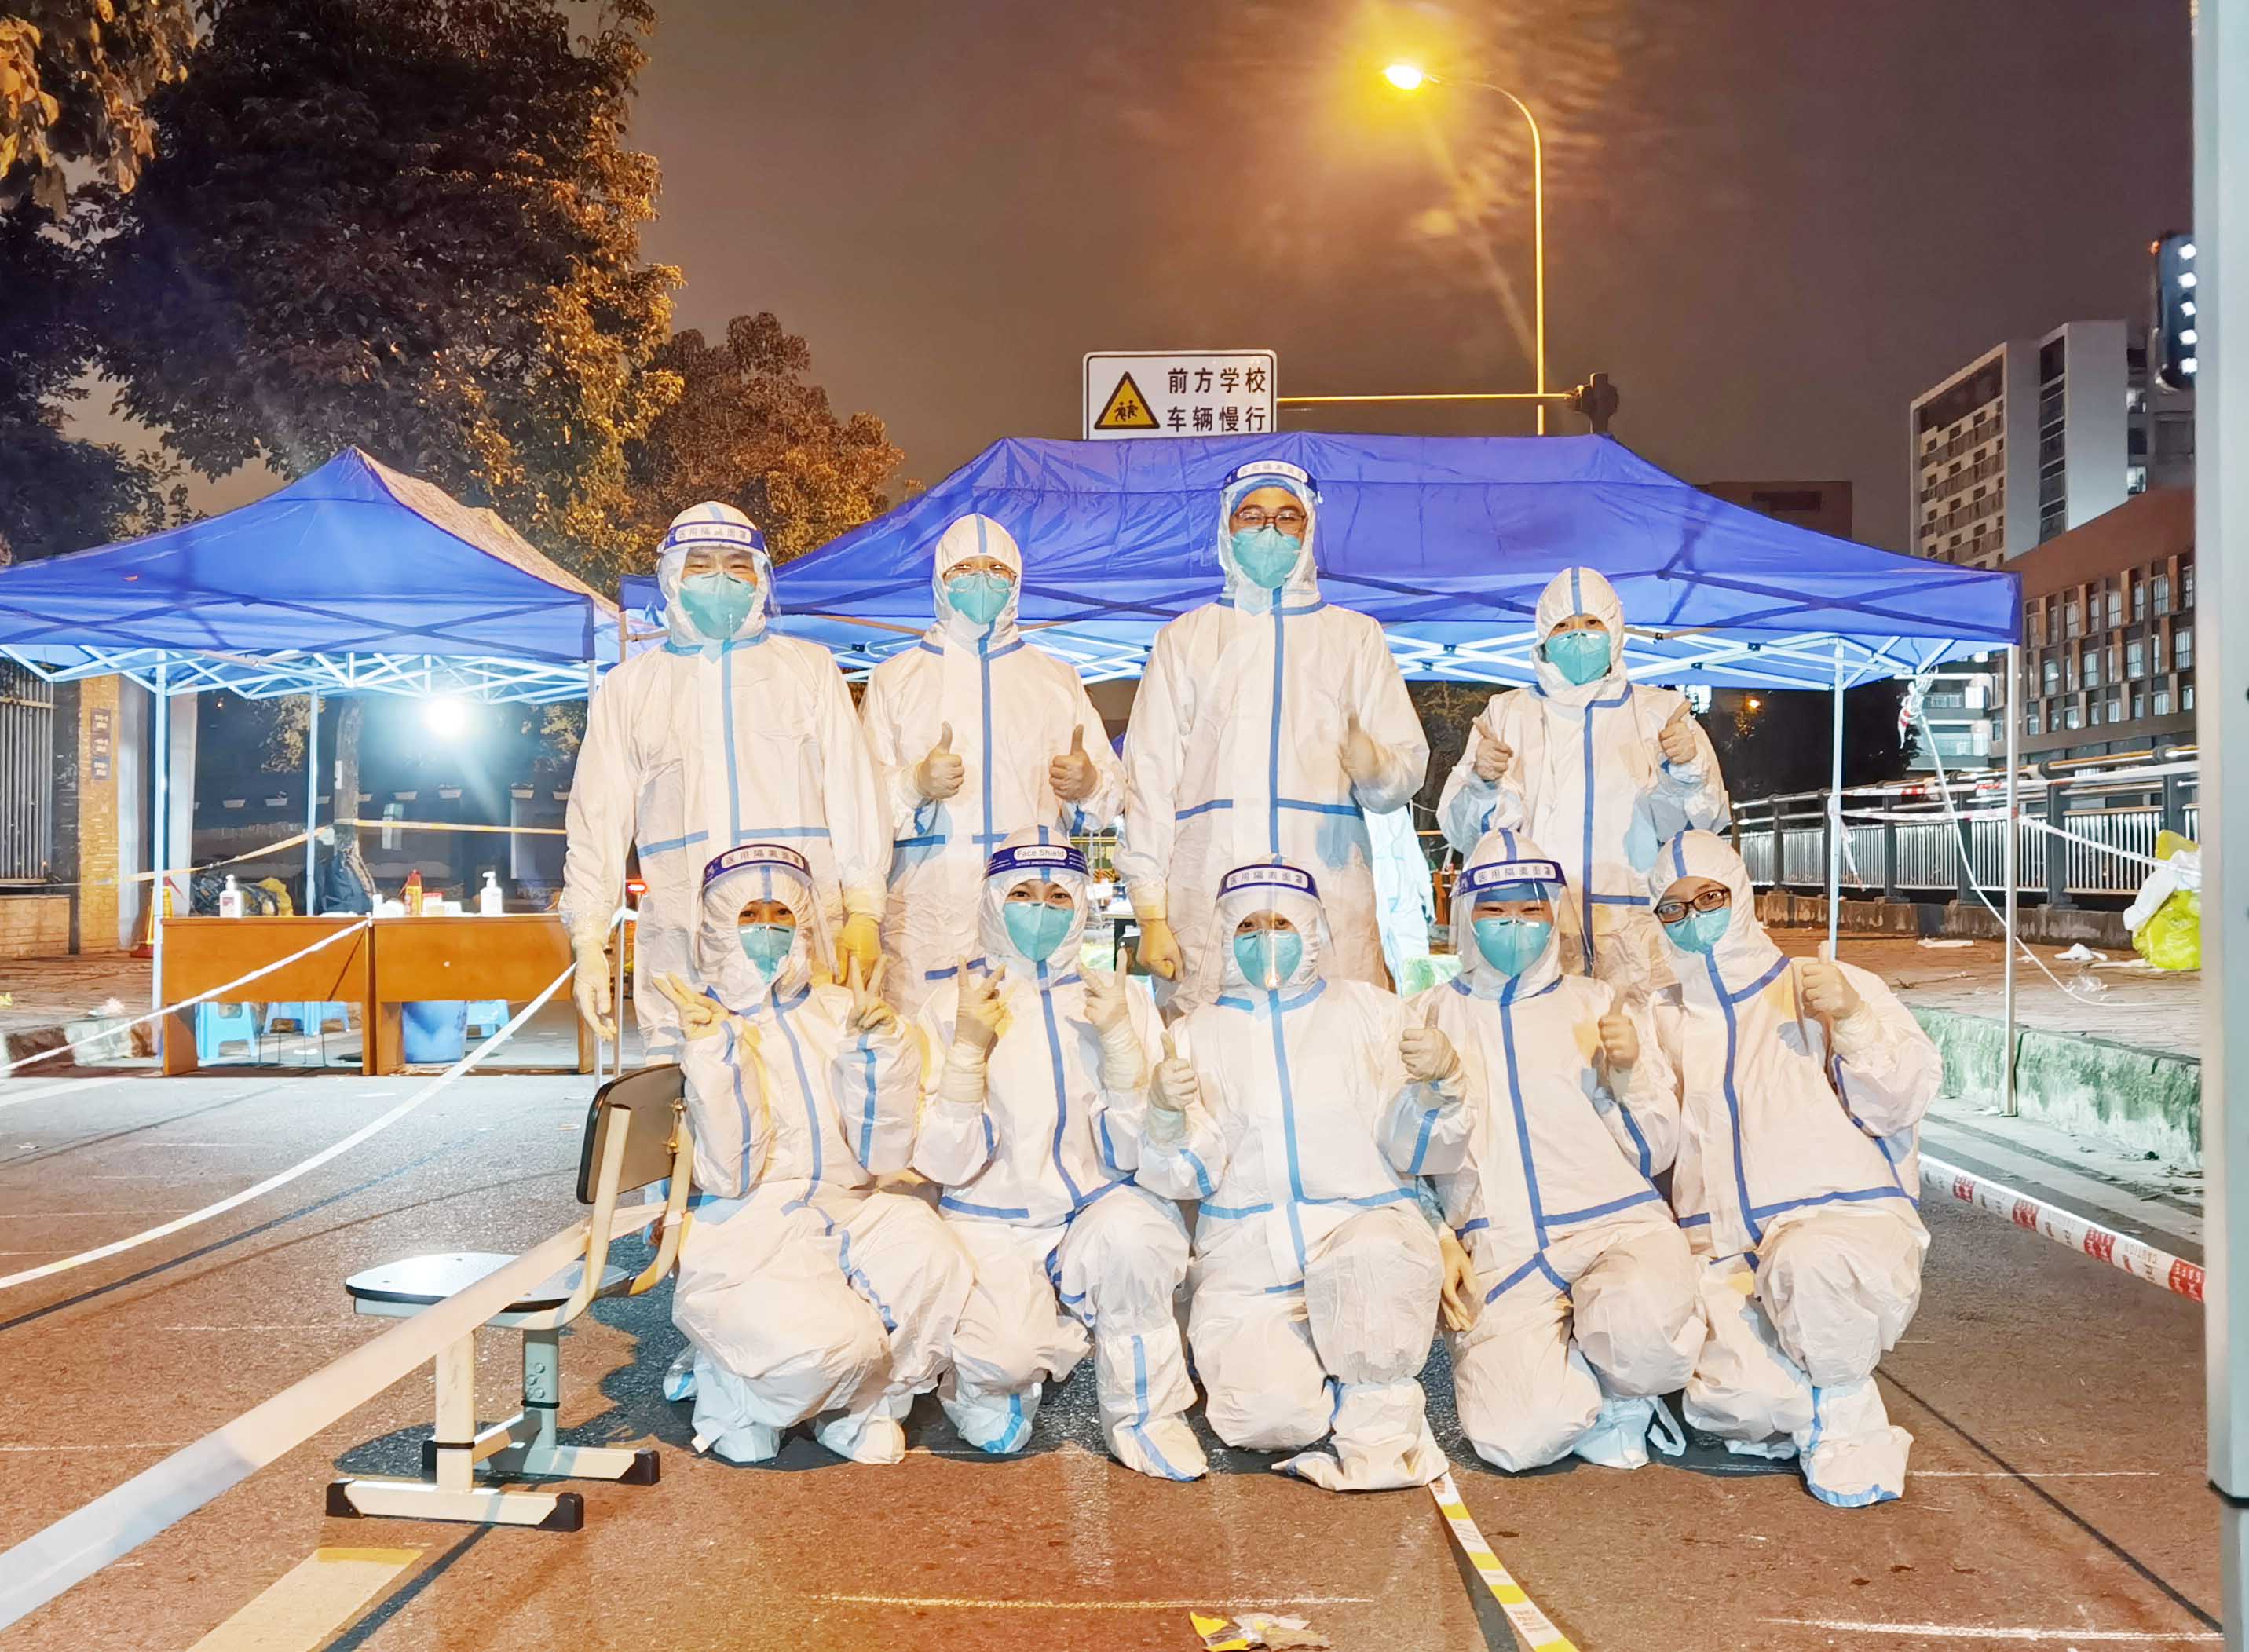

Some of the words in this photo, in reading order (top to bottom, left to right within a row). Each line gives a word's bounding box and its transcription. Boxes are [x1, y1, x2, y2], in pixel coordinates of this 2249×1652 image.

[1168, 367, 1267, 394] 前方学校
[1167, 406, 1266, 433] 车辆慢行
[1040, 848, 1065, 857] Shield
